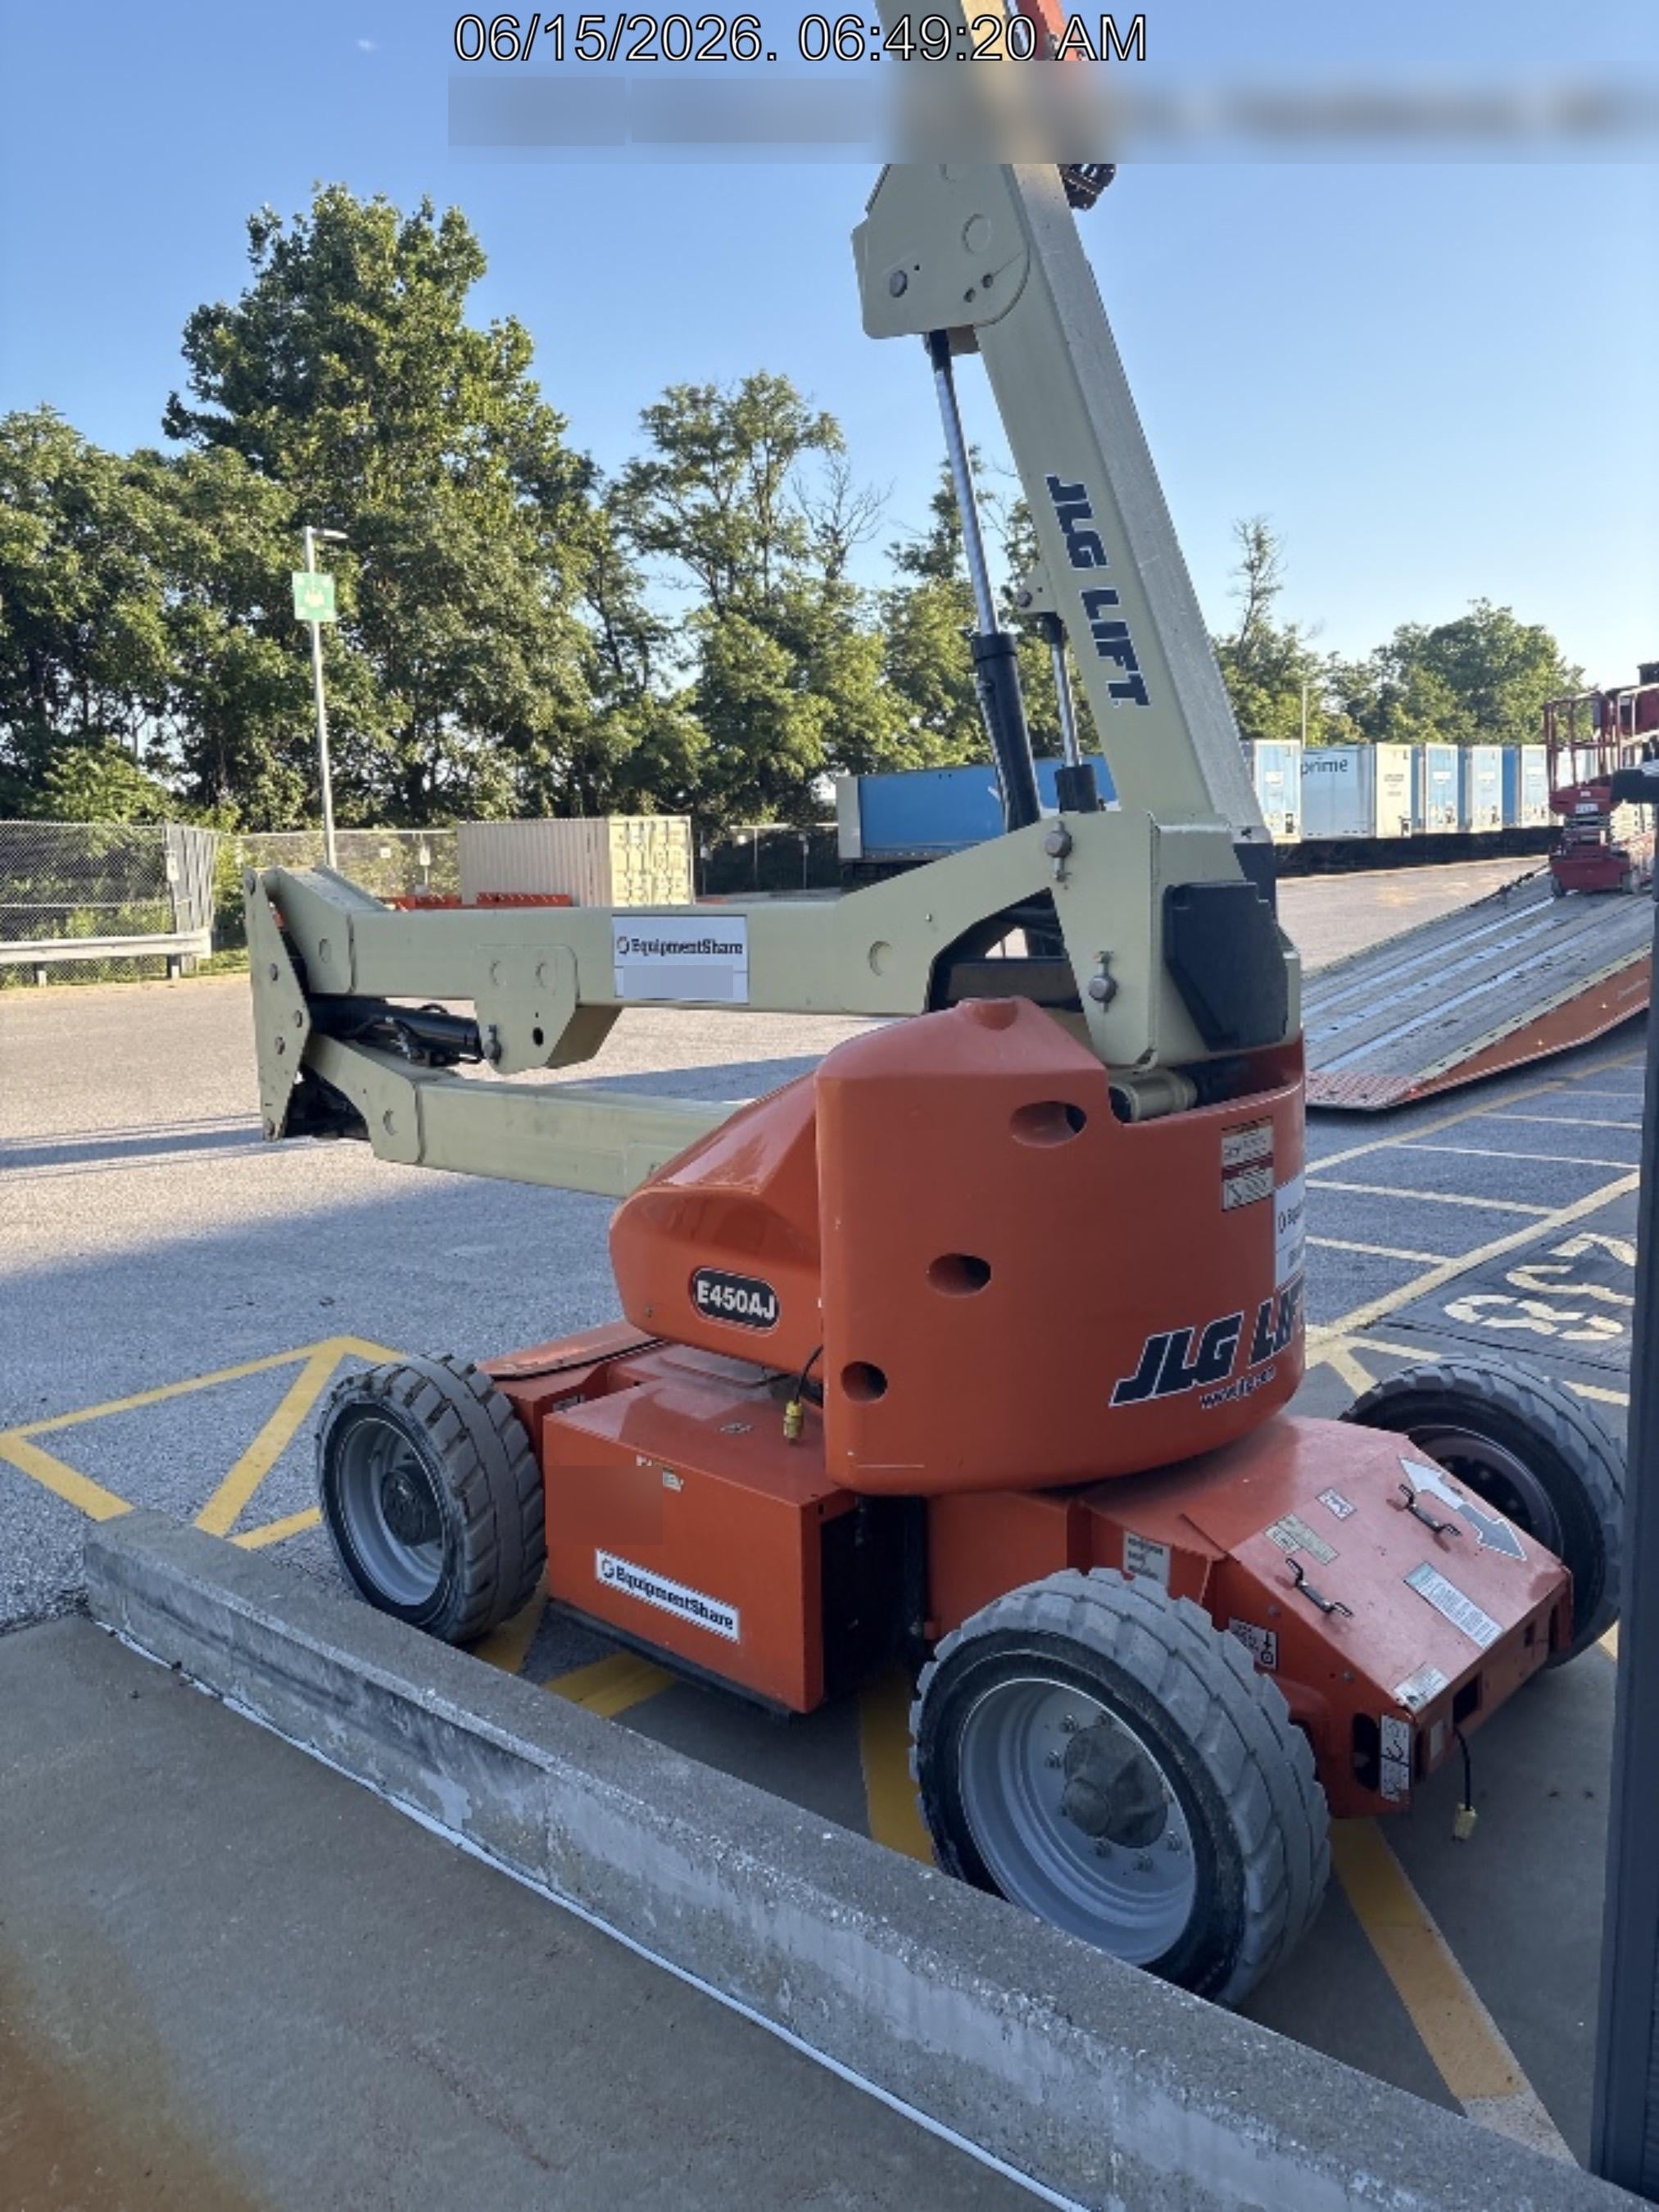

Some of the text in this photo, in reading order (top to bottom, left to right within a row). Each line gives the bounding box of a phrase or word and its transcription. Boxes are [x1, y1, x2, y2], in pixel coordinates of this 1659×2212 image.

[1046, 474, 1151, 706] JLG LIFT
[630, 938, 743, 957] EquipmentShare
[696, 1279, 776, 1321] E450AJ
[1108, 1311, 1244, 1407] JLG
[616, 1565, 734, 1630] EquipmentShare
